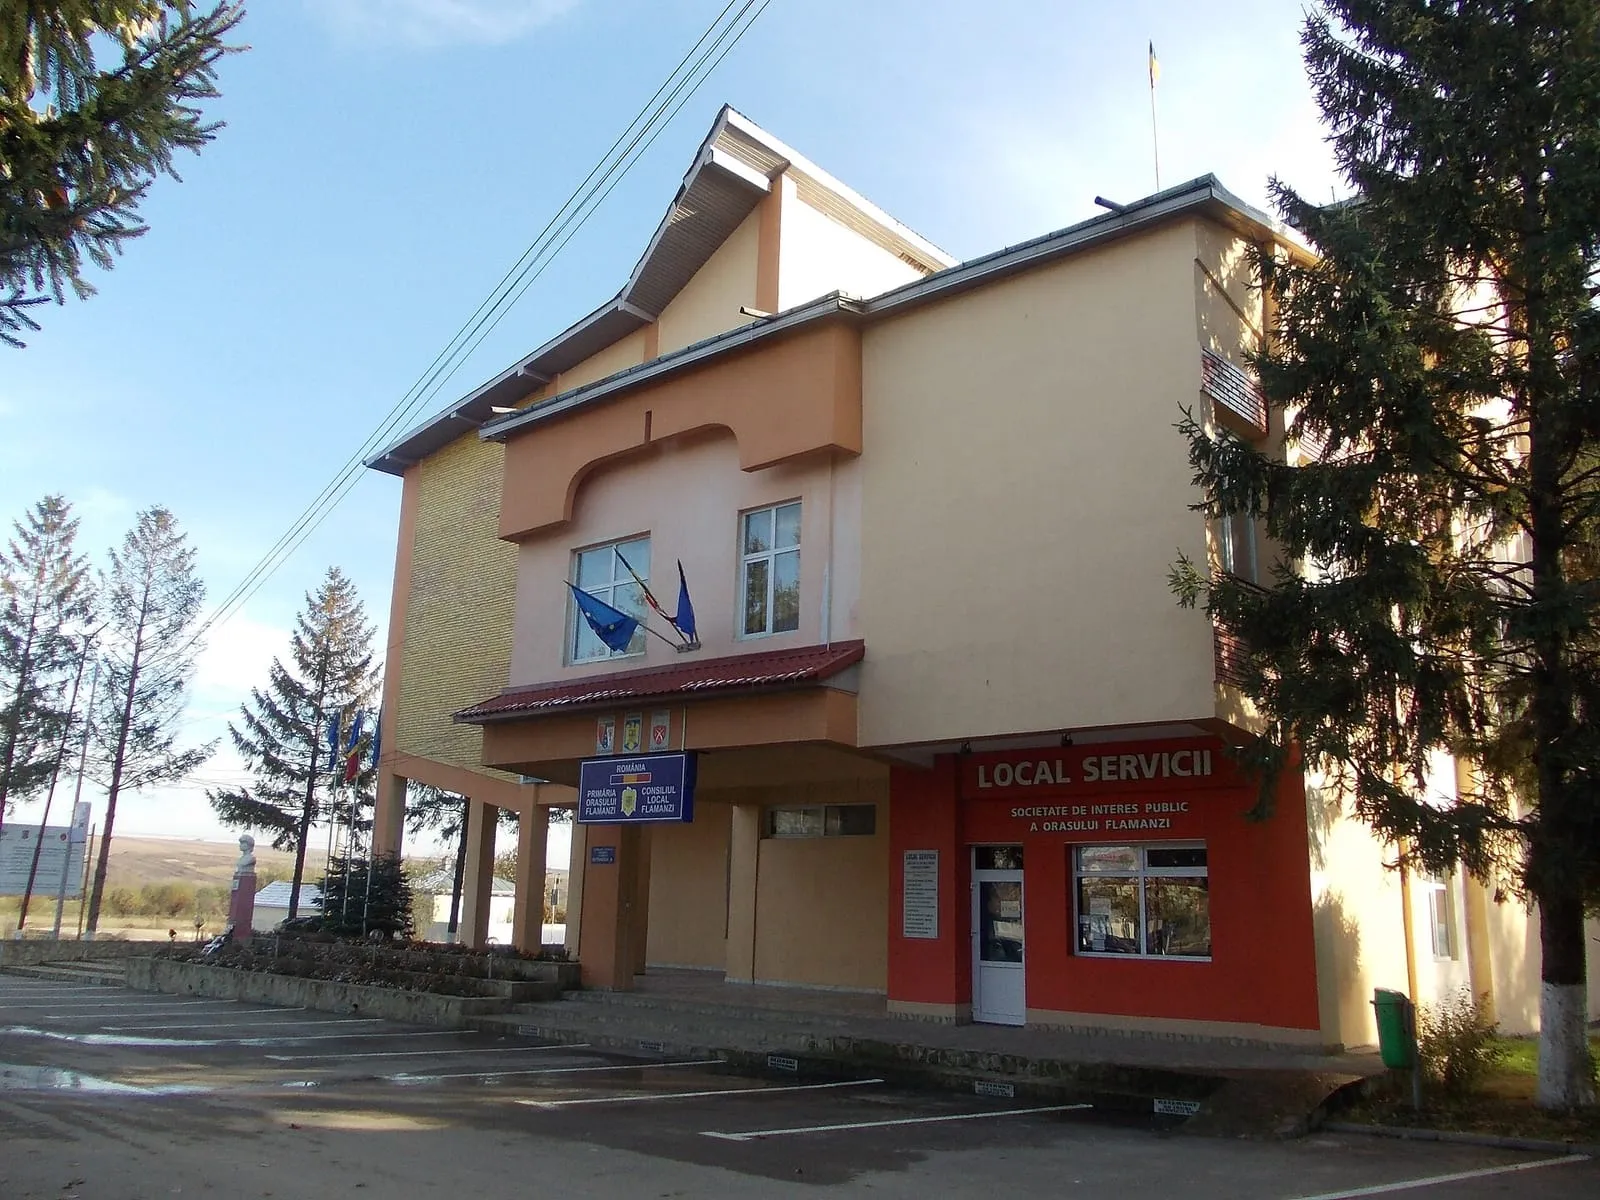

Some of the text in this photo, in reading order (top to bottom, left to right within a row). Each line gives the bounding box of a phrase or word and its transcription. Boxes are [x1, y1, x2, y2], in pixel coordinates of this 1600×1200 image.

[616, 762, 646, 773] ROMÂNIA
[978, 749, 1213, 788] LOCAL SERVICII
[641, 785, 676, 796] CONSILIUL
[647, 795, 670, 804] LOCAL
[1011, 801, 1189, 817] SOCIETATE DE INTERES PUBLIC
[1030, 818, 1171, 832] A ORASULUI FLAMANZI
